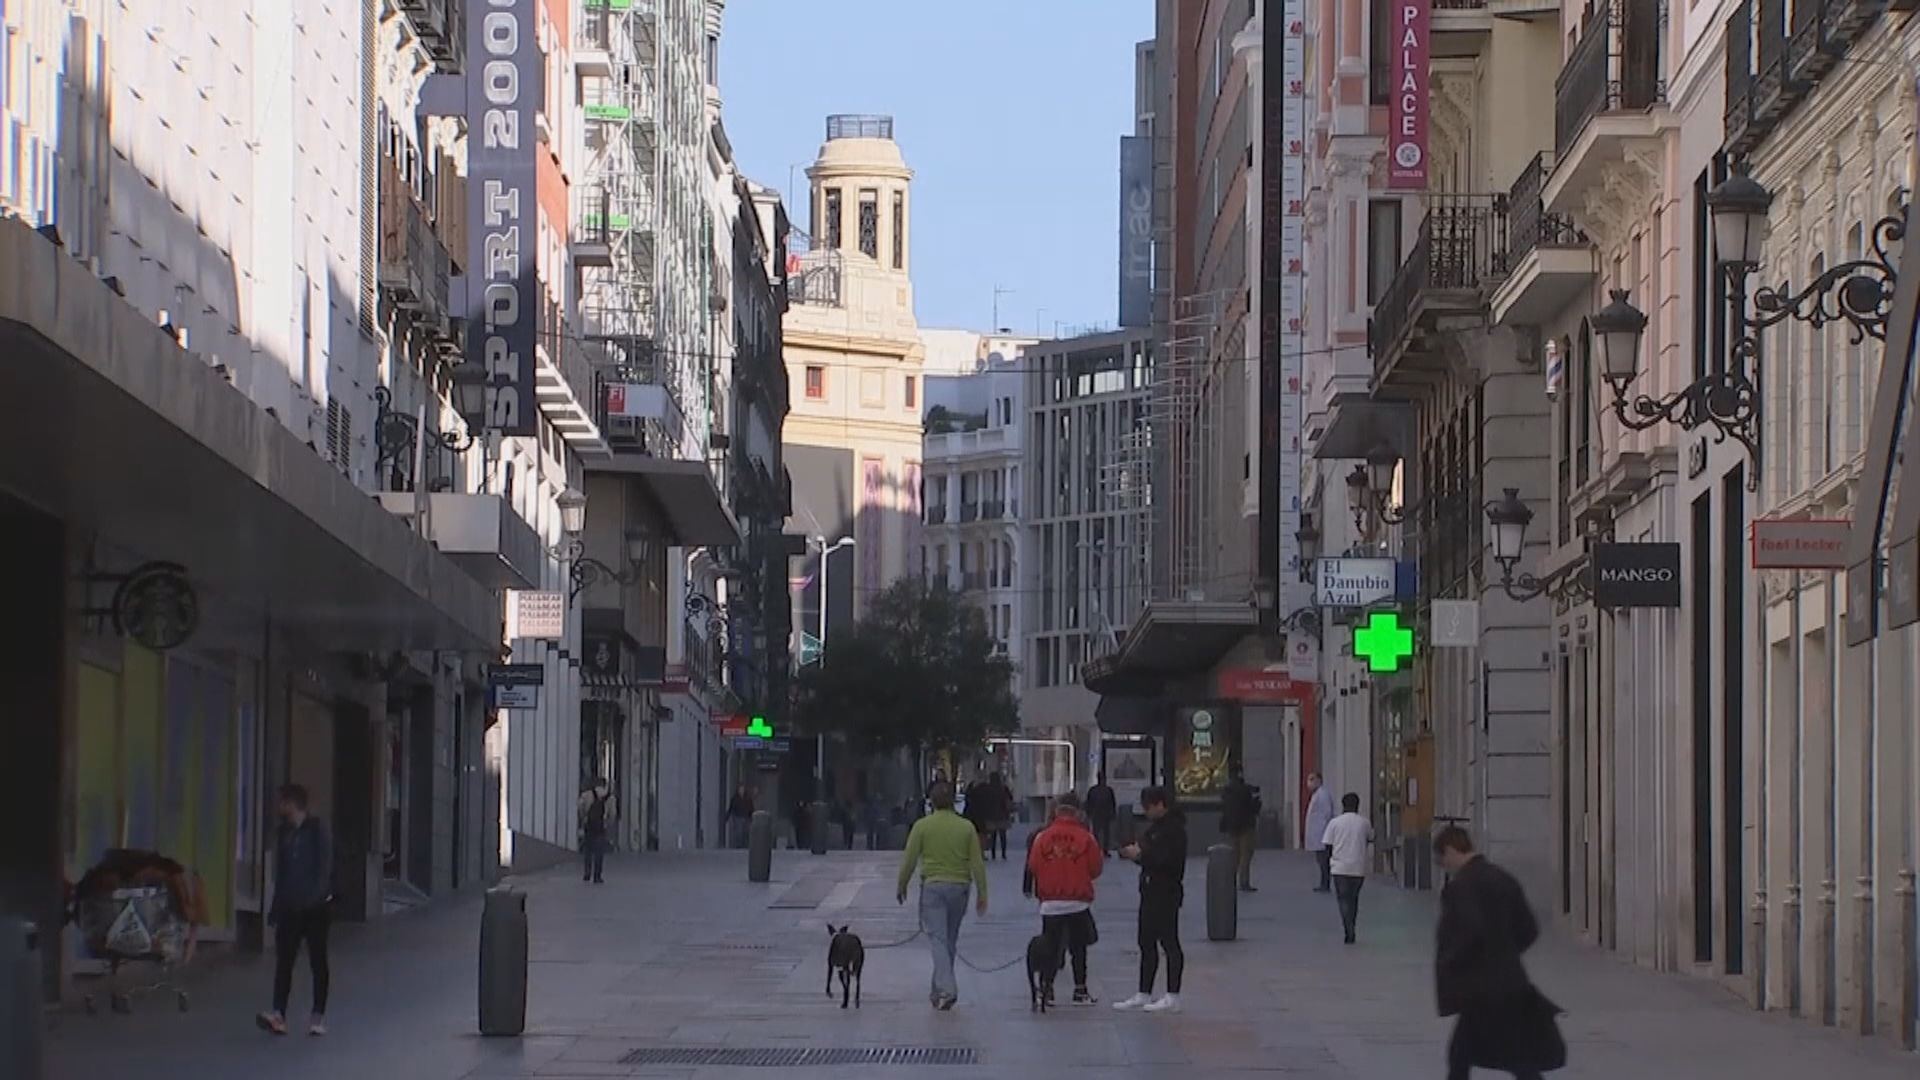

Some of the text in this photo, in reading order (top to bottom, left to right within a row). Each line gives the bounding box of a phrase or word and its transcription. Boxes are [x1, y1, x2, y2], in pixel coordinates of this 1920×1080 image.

[1290, 21, 1302, 34] 40
[1402, 6, 1418, 136] PALACE
[483, 0, 519, 428] SPORT 200
[1324, 560, 1341, 574] El
[1601, 567, 1673, 582] MANGO
[1324, 575, 1390, 589] Danubio
[1323, 589, 1362, 604] Azul
